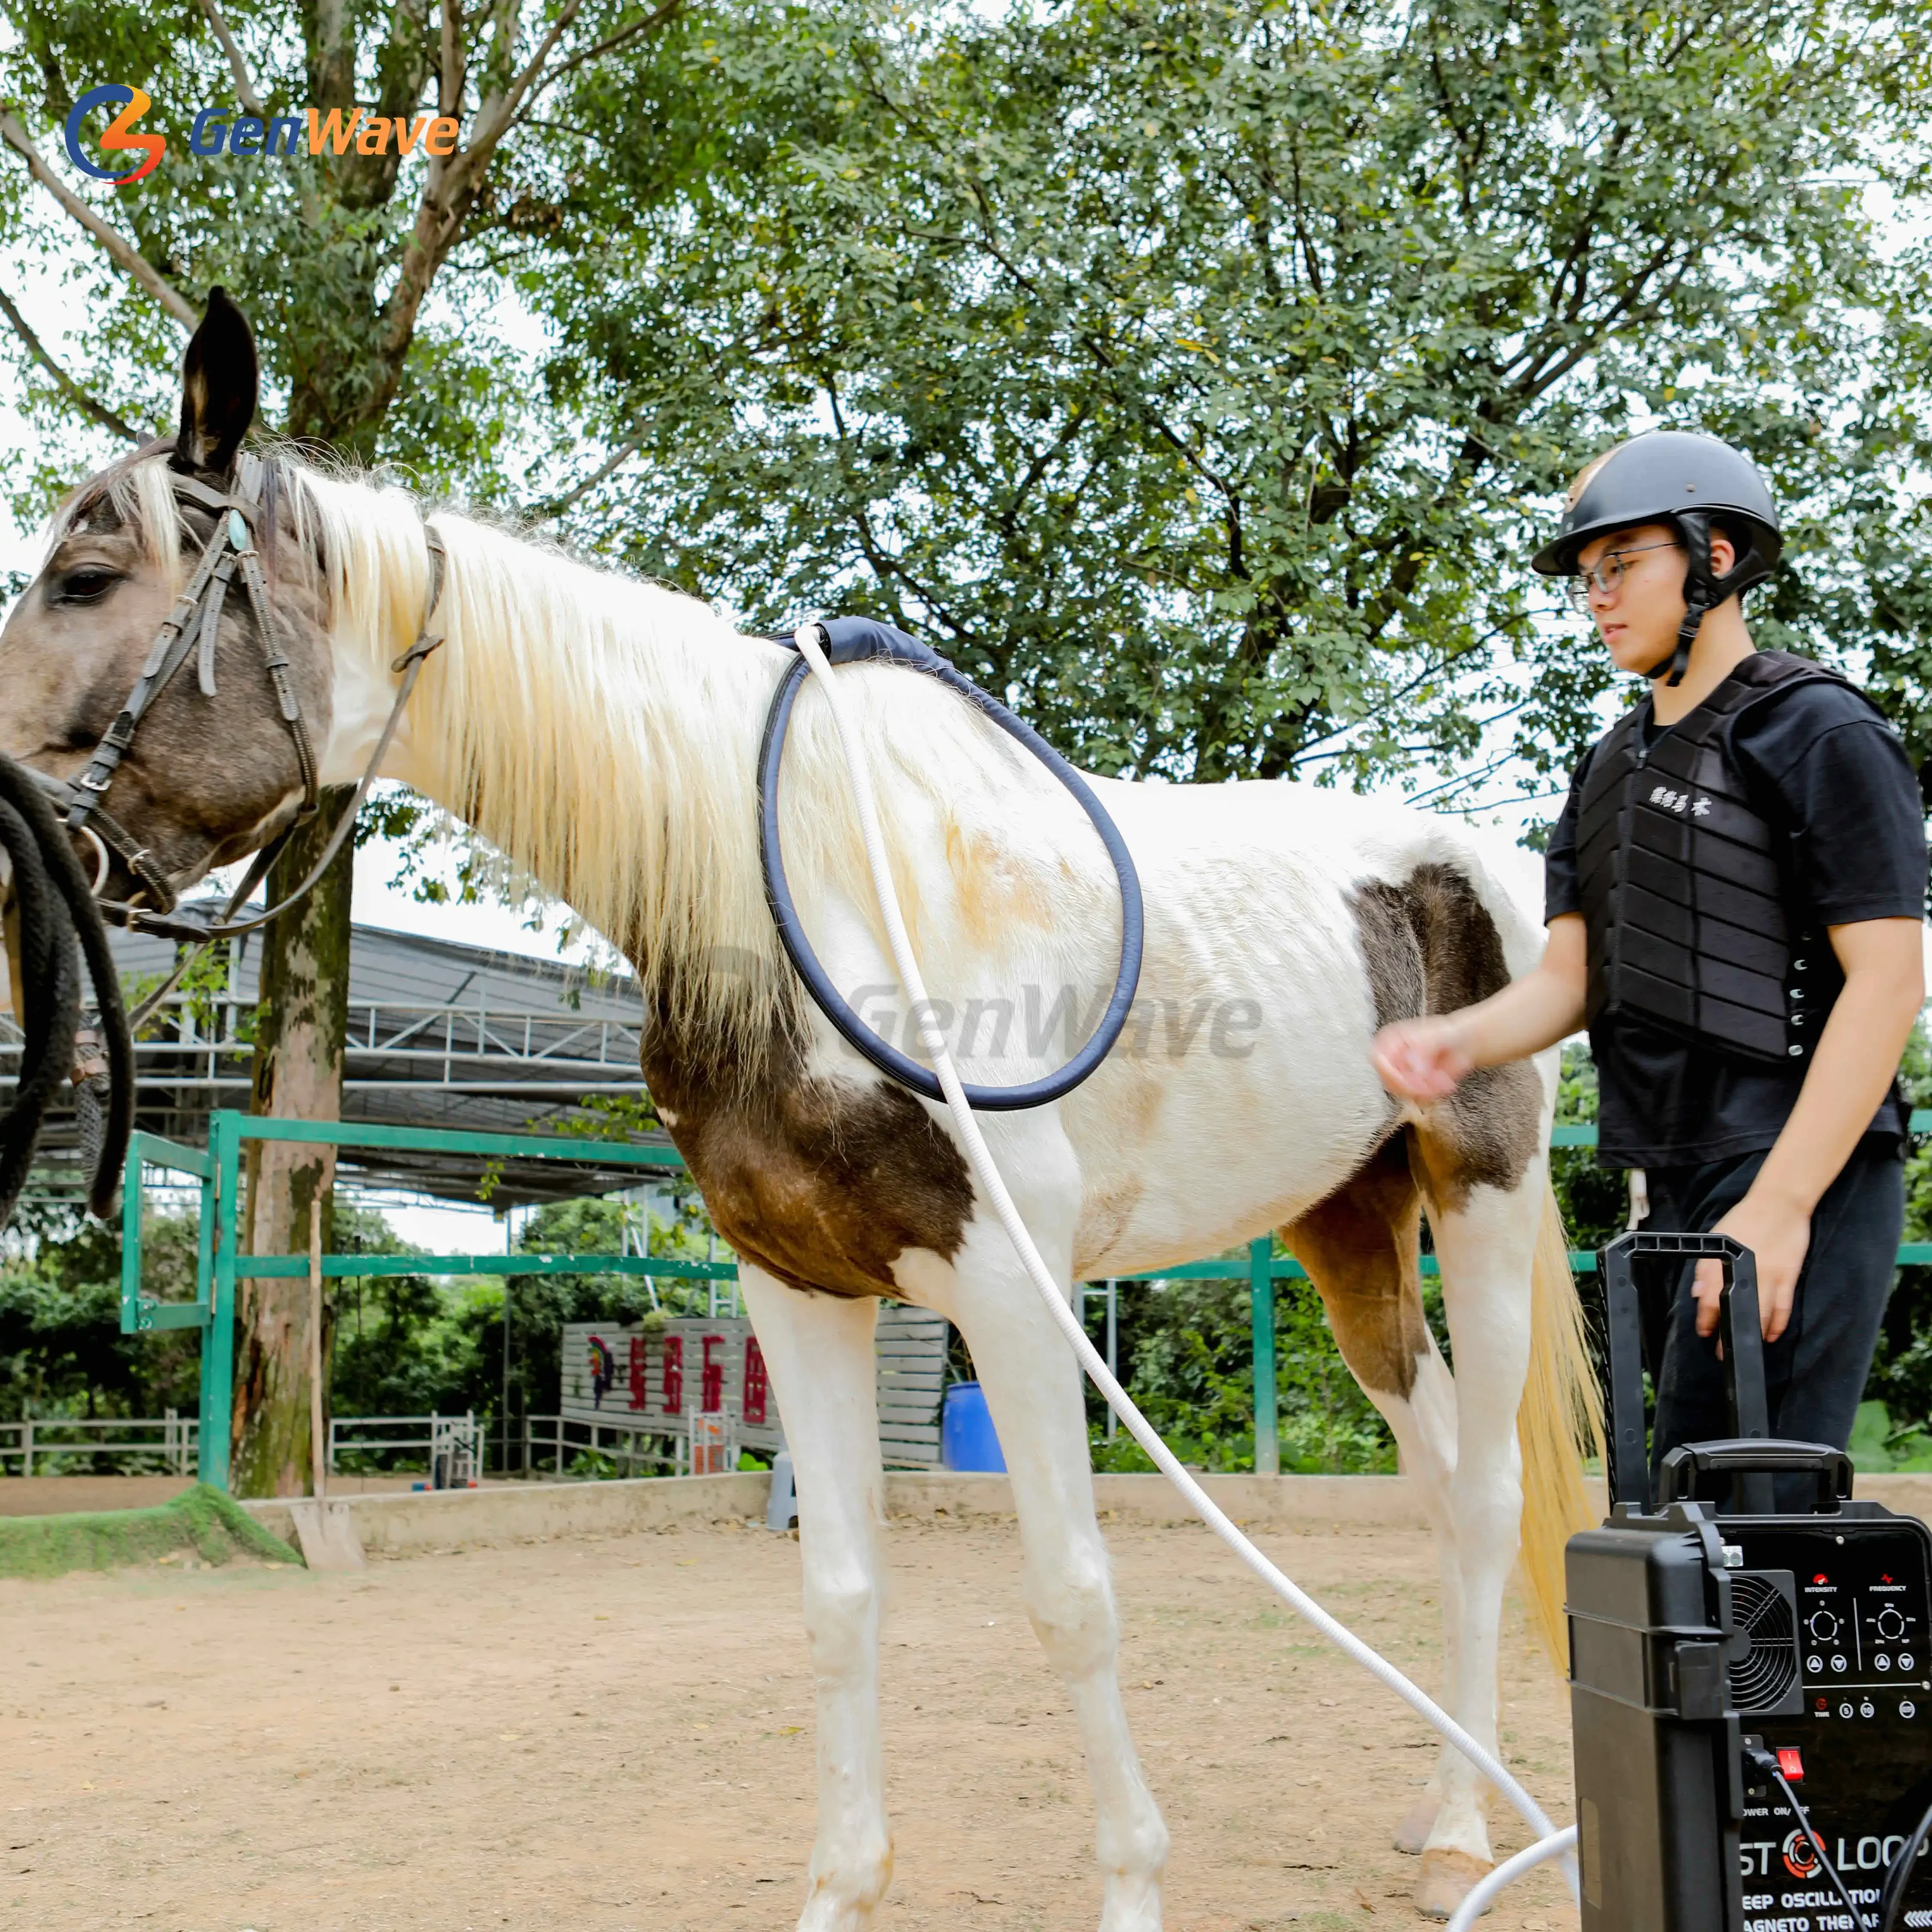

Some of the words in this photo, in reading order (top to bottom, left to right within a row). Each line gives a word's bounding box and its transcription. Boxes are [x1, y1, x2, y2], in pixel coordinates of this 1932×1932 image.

[1743, 1807, 1769, 1816] OWER
[1739, 1842, 1777, 1876] ST
[1742, 1894, 1774, 1910] EEP
[1781, 1888, 1880, 1908] OSCILLTIO
[1744, 1917, 1810, 1932] AGNETO
